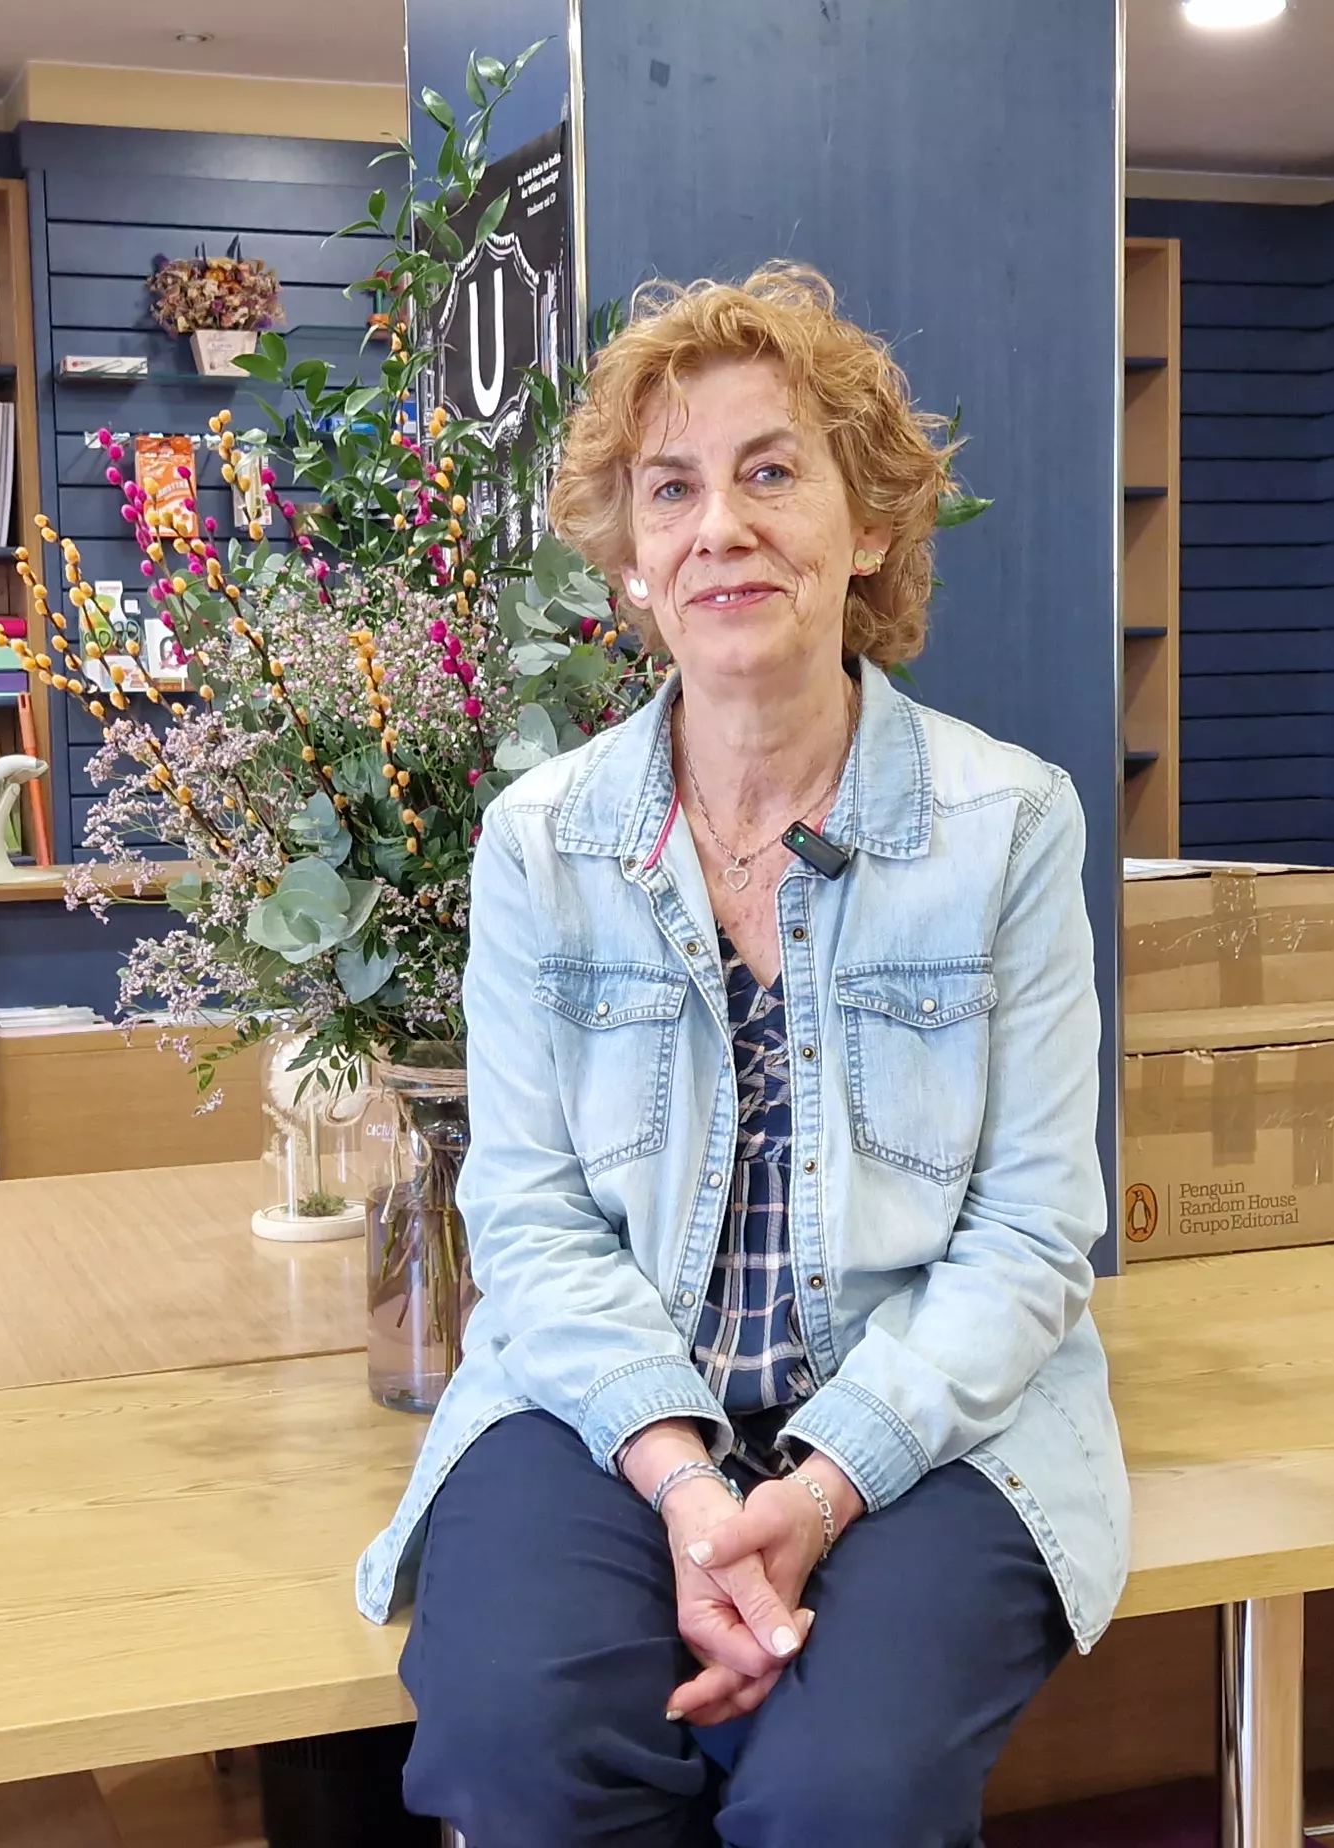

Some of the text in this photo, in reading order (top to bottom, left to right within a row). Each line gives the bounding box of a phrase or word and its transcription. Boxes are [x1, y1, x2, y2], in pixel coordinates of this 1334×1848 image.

[468, 267, 505, 417] U
[1179, 1180, 1245, 1200] Penguin
[1179, 1193, 1297, 1216] Random House
[1179, 1209, 1299, 1236] Grupo Editorial
